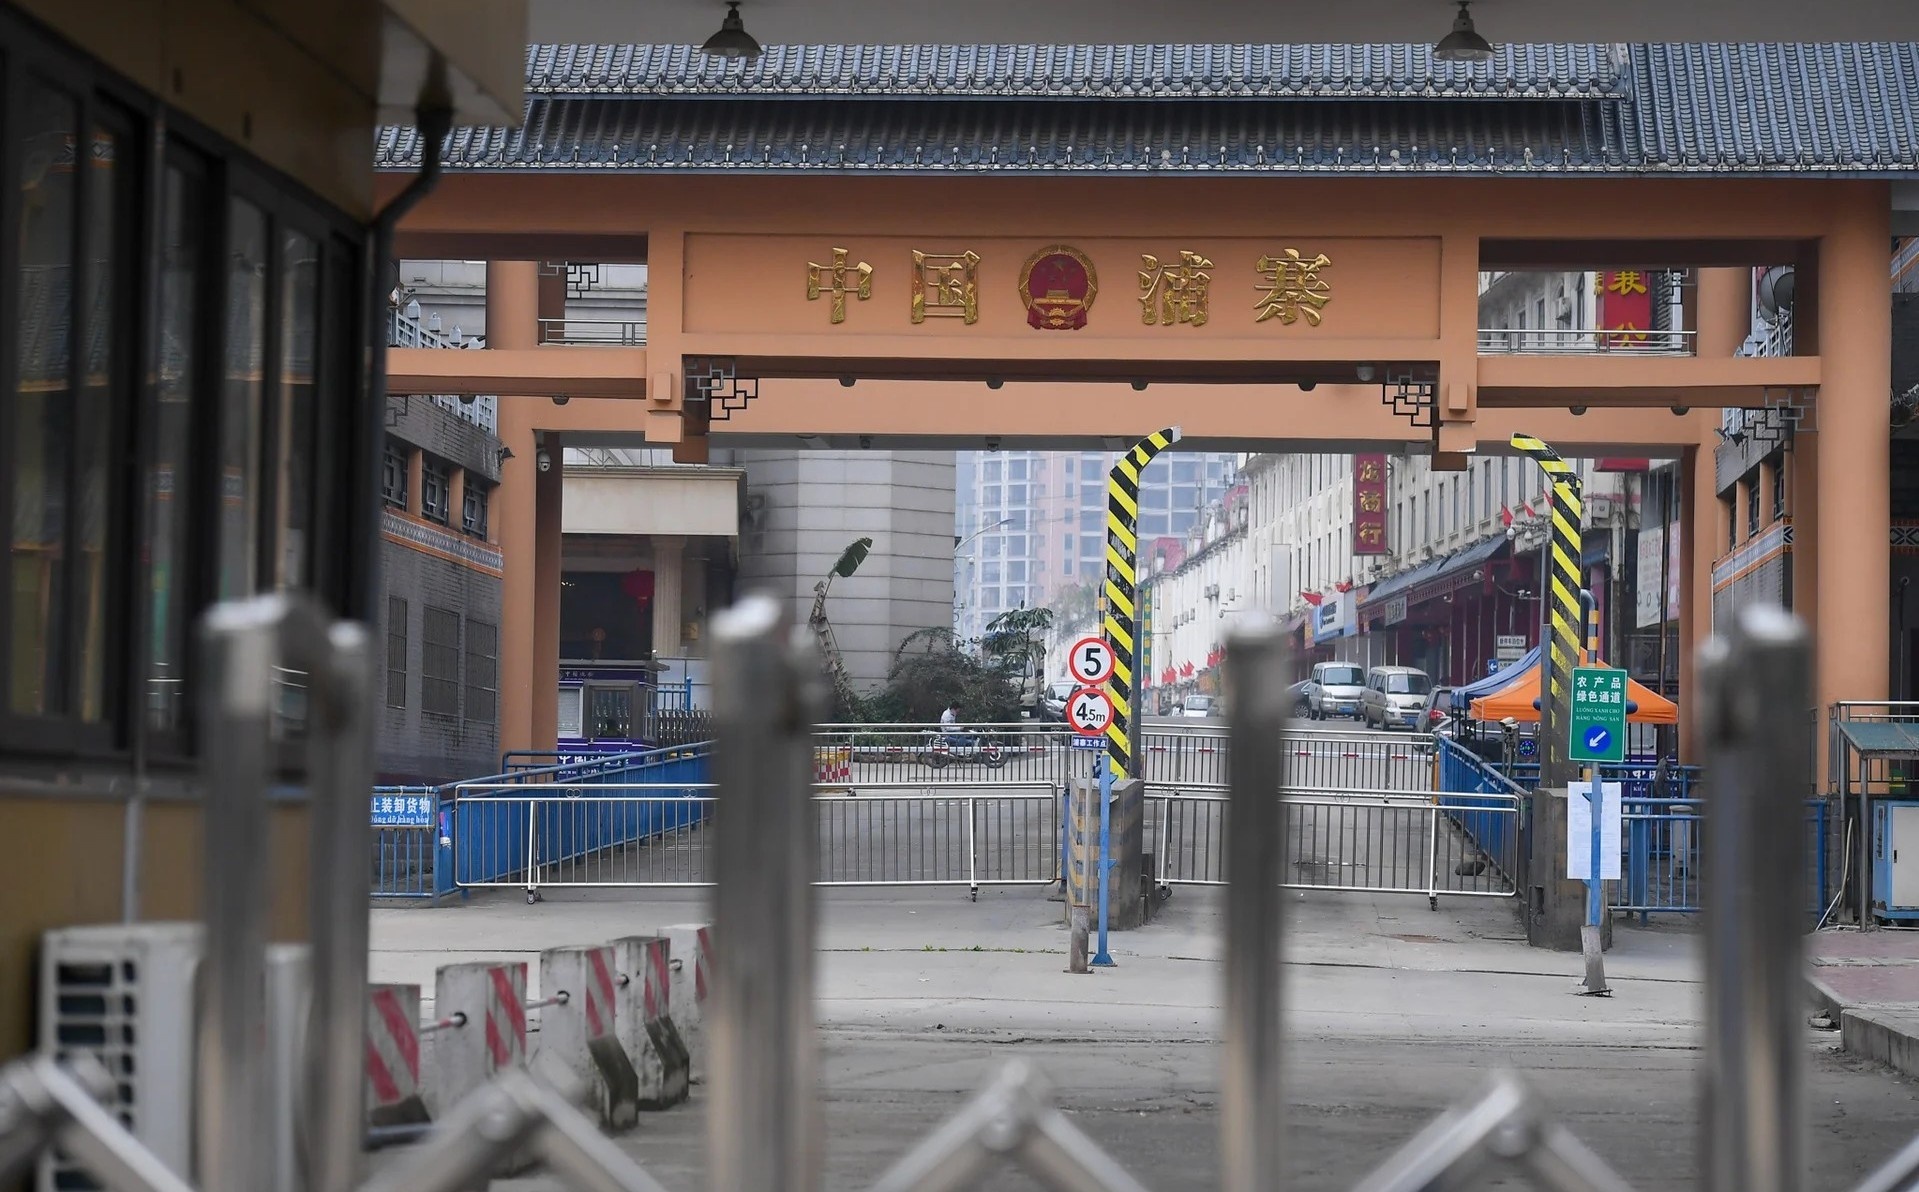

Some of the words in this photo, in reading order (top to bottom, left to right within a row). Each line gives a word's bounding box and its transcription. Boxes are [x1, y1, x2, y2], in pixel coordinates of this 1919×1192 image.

[806, 247, 980, 325] 中国
[1138, 248, 1332, 327] 浦寨
[1083, 647, 1102, 677] 5
[1576, 675, 1621, 689] 农产品
[1576, 690, 1621, 704] 绿色通道
[1075, 702, 1106, 722] 4.5m
